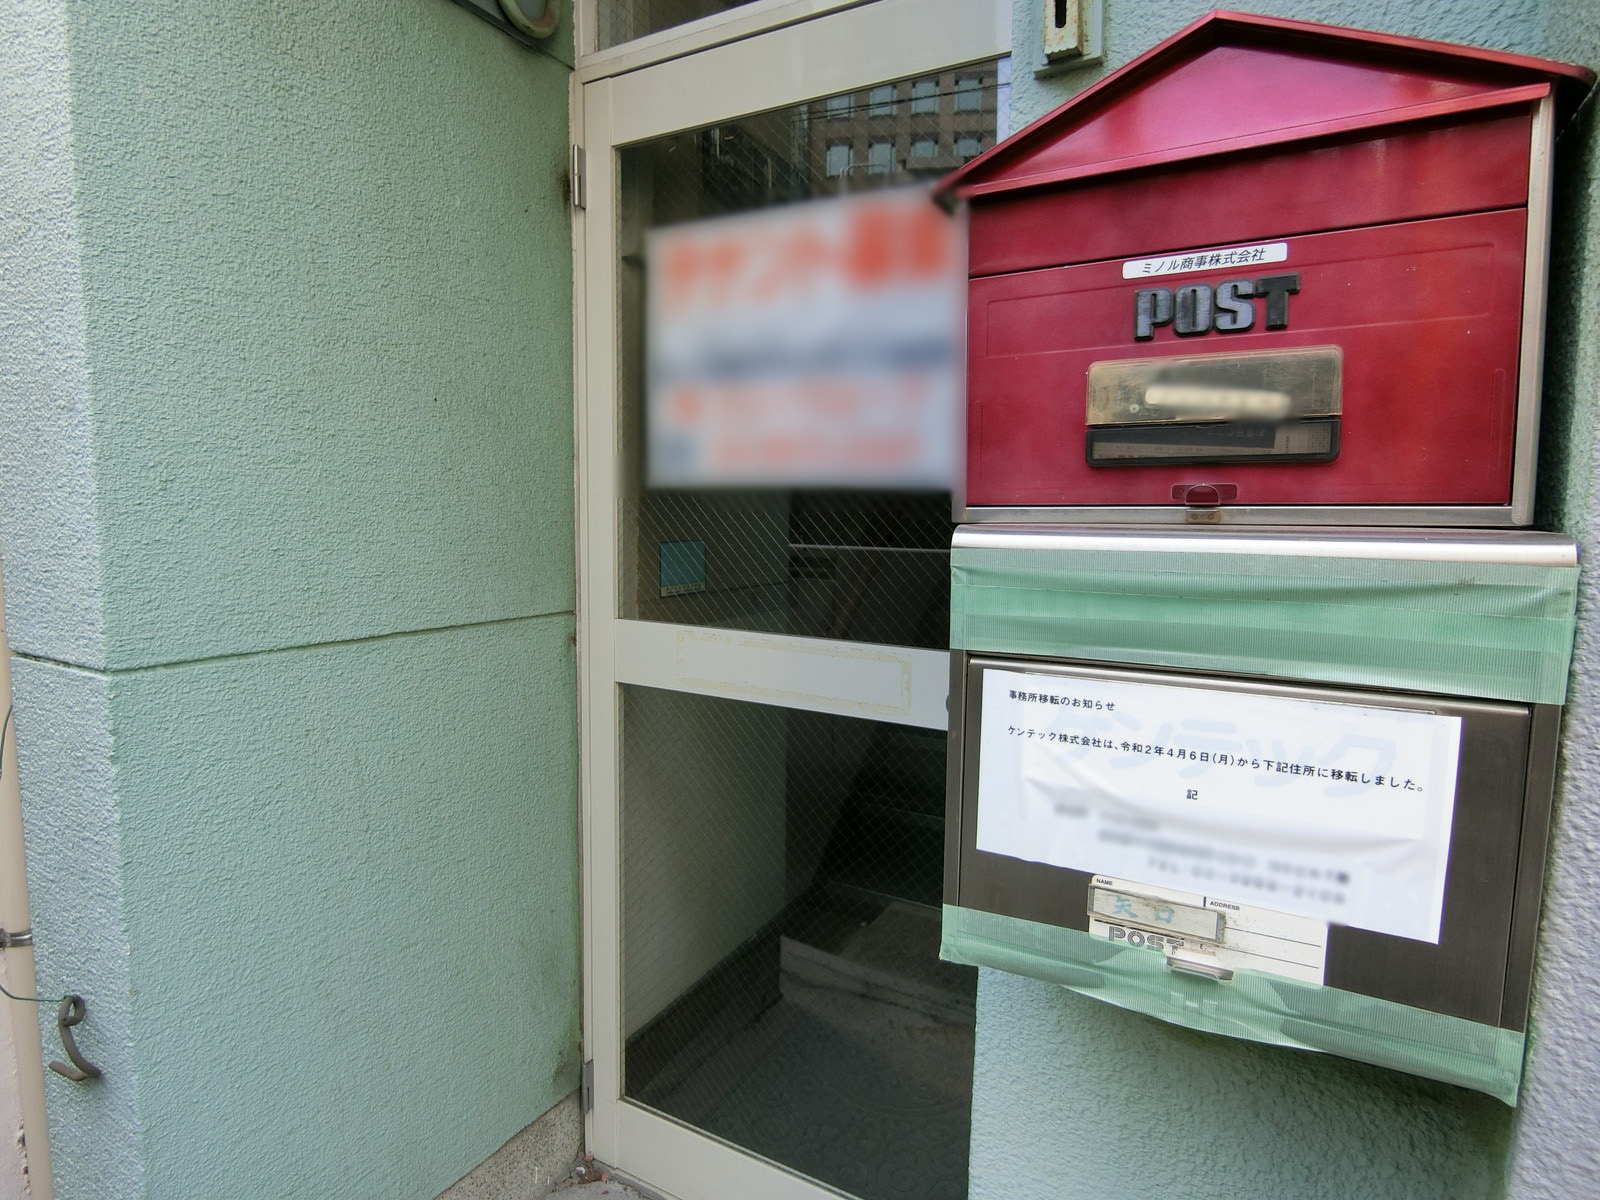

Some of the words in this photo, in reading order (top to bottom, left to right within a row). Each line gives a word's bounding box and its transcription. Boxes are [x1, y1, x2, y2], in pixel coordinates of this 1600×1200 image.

[1142, 248, 1266, 273] ミノル商事株式会社
[1134, 272, 1300, 342] POST
[1009, 690, 1115, 711] 事務所移転のお知らせ
[1186, 788, 1199, 801] 記
[1096, 878, 1113, 886] NAME
[1209, 900, 1240, 911] ADDRESS
[1108, 926, 1185, 955] POST
